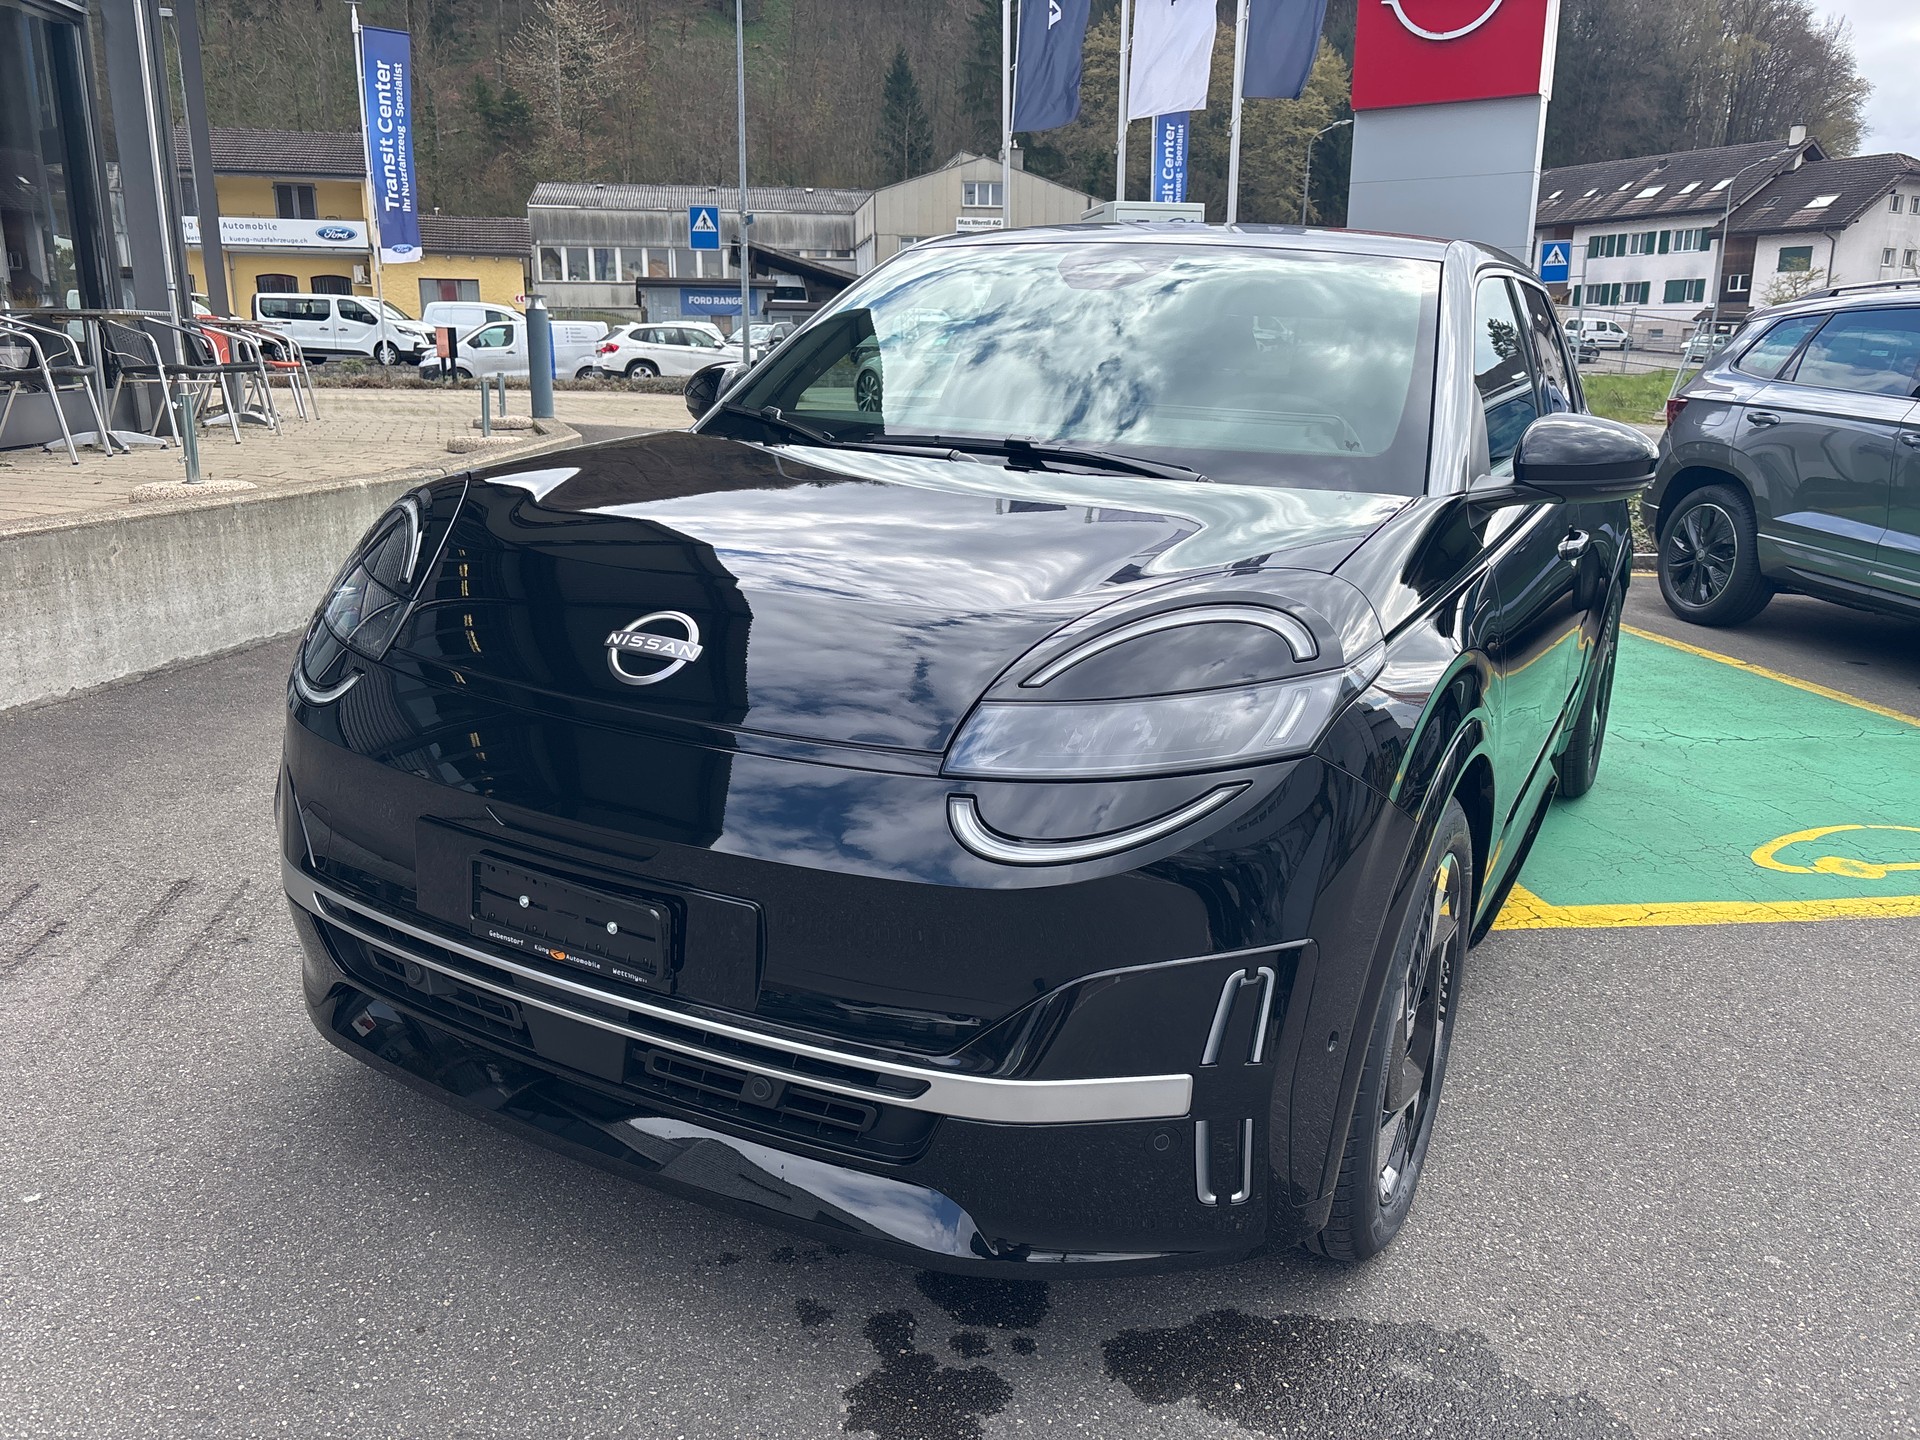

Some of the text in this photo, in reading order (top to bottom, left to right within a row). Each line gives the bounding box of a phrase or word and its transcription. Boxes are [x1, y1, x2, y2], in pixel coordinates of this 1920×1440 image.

[394, 63, 404, 117] Spezialist
[376, 60, 399, 212] Transit Center
[1175, 124, 1184, 167] Spezialist
[397, 126, 410, 196] Nutzfahrzeug
[1162, 123, 1176, 203] sit Center
[1175, 172, 1183, 203] hrzeug
[402, 193, 411, 212] Ihr
[222, 222, 277, 231] Automobile
[321, 227, 351, 240] Ford
[229, 236, 308, 244] kueng-nutzfahrzeuge.ch
[688, 296, 743, 305] FORD RANGE
[606, 633, 698, 659] NISSAN
[488, 929, 523, 946] Gebenstorf
[534, 944, 601, 970] Küng Automobile
